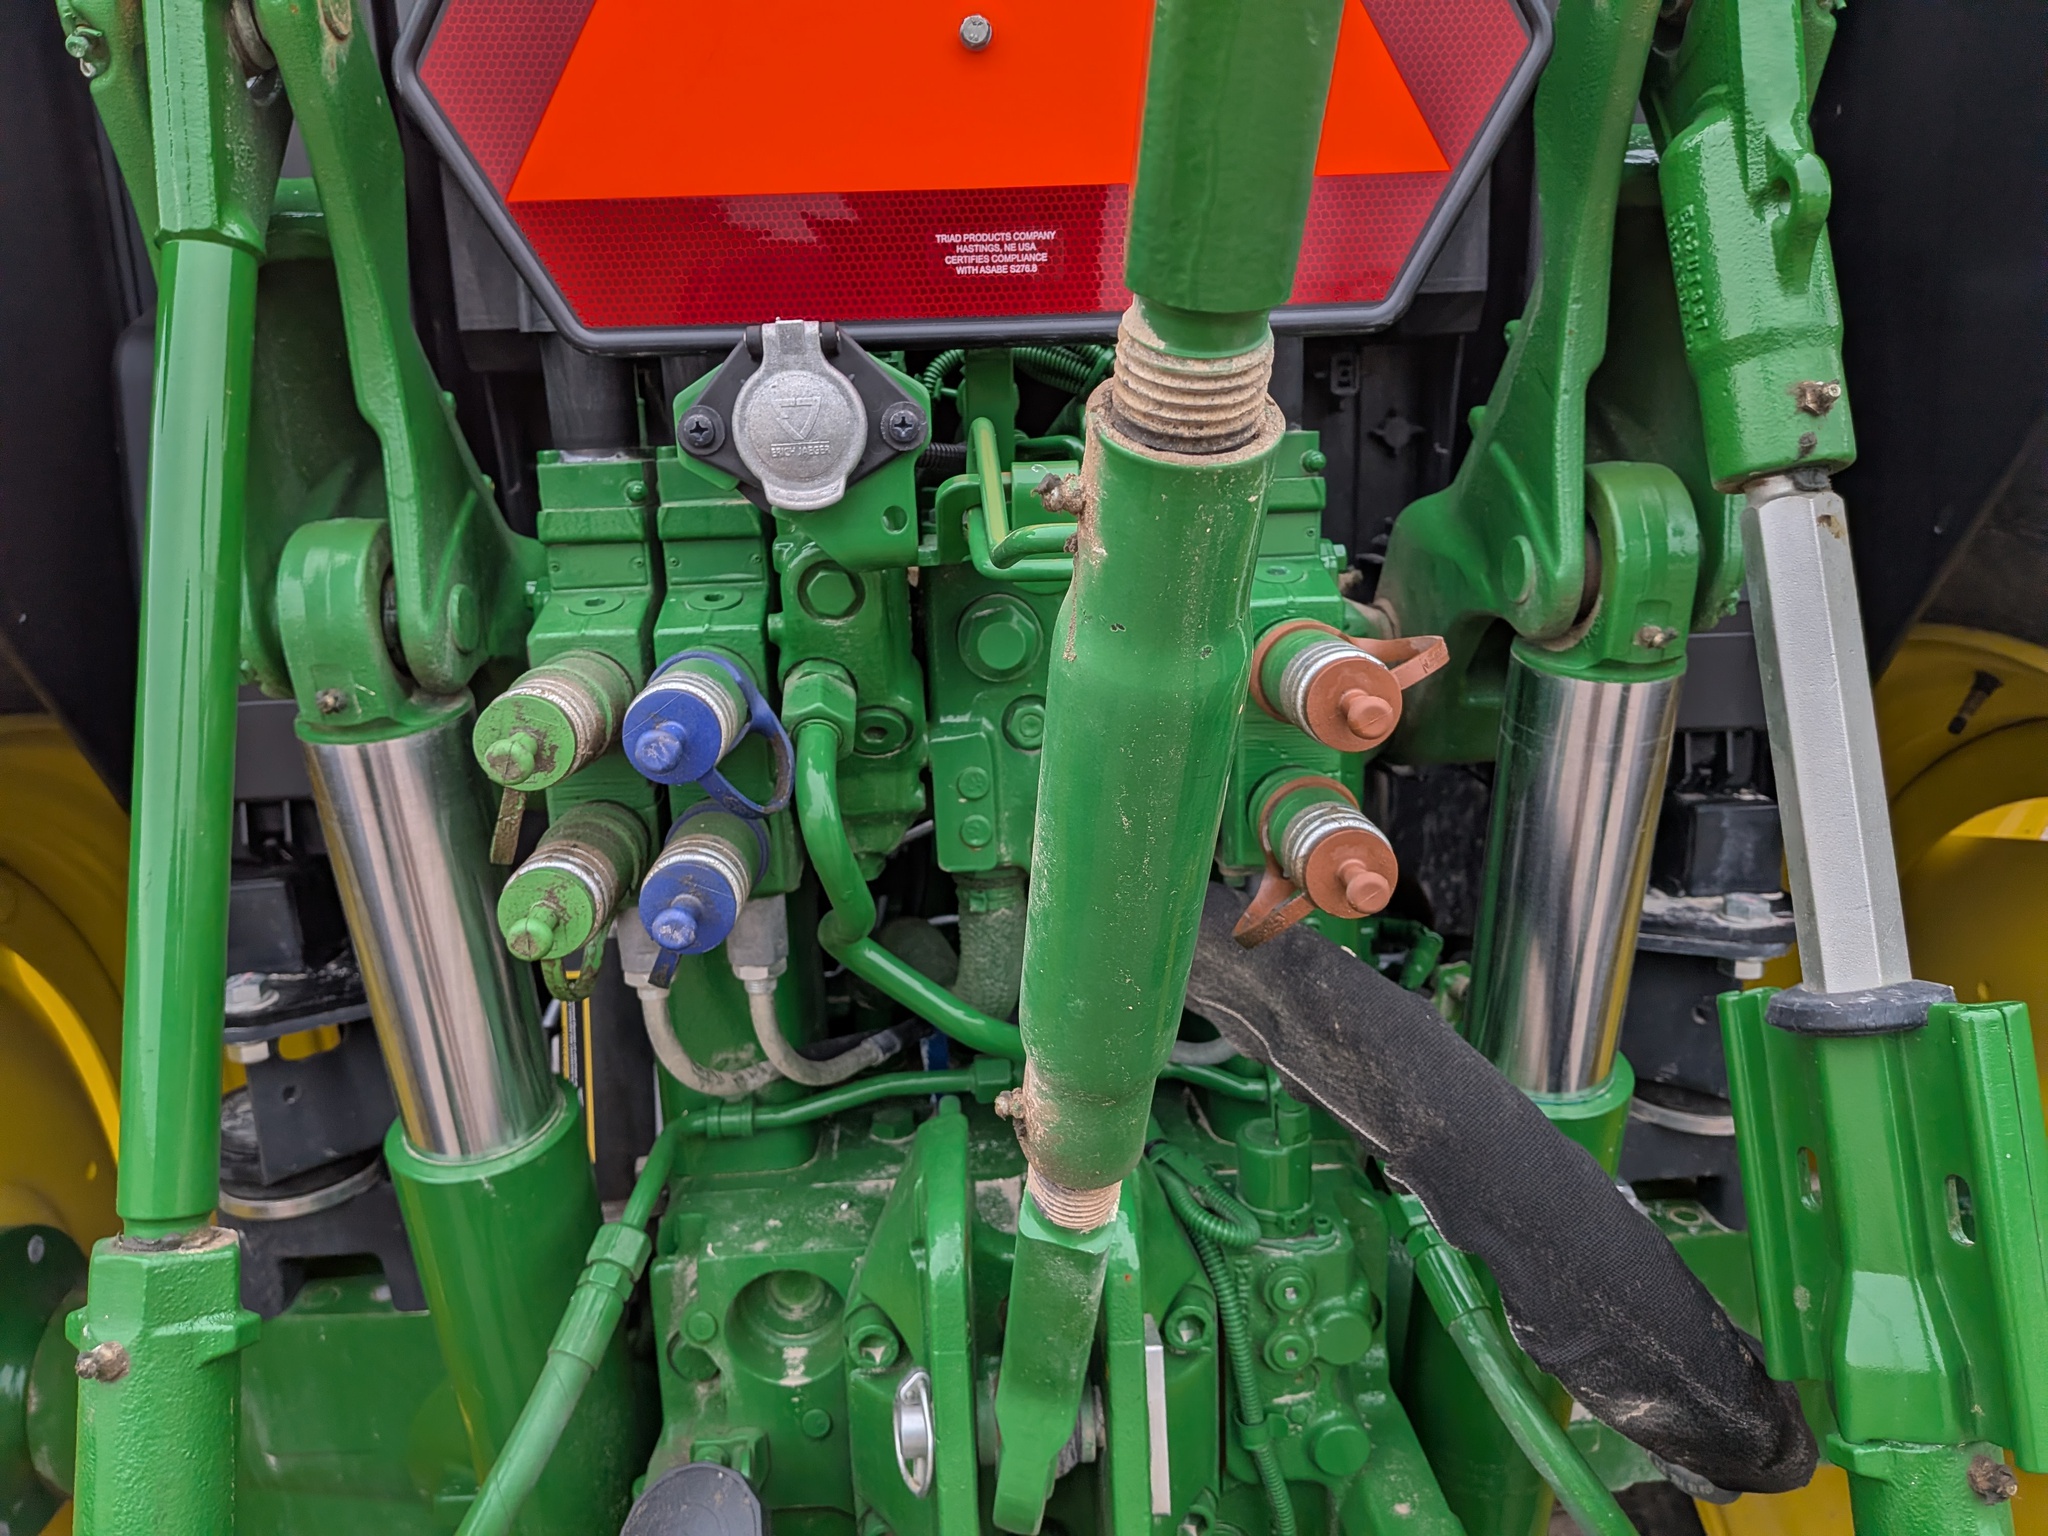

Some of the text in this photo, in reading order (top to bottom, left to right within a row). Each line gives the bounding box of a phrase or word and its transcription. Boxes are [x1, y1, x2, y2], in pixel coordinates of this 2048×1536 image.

[935, 231, 1056, 243] TRIAD PRODUCTS COMPANY
[956, 242, 1037, 254] HASTINGS, NE USA
[944, 252, 1048, 265] CERTIFIES COMPLIANCE
[955, 266, 979, 275] WITH
[979, 264, 1009, 274] ASABE
[798, 444, 830, 456] JAEGER
